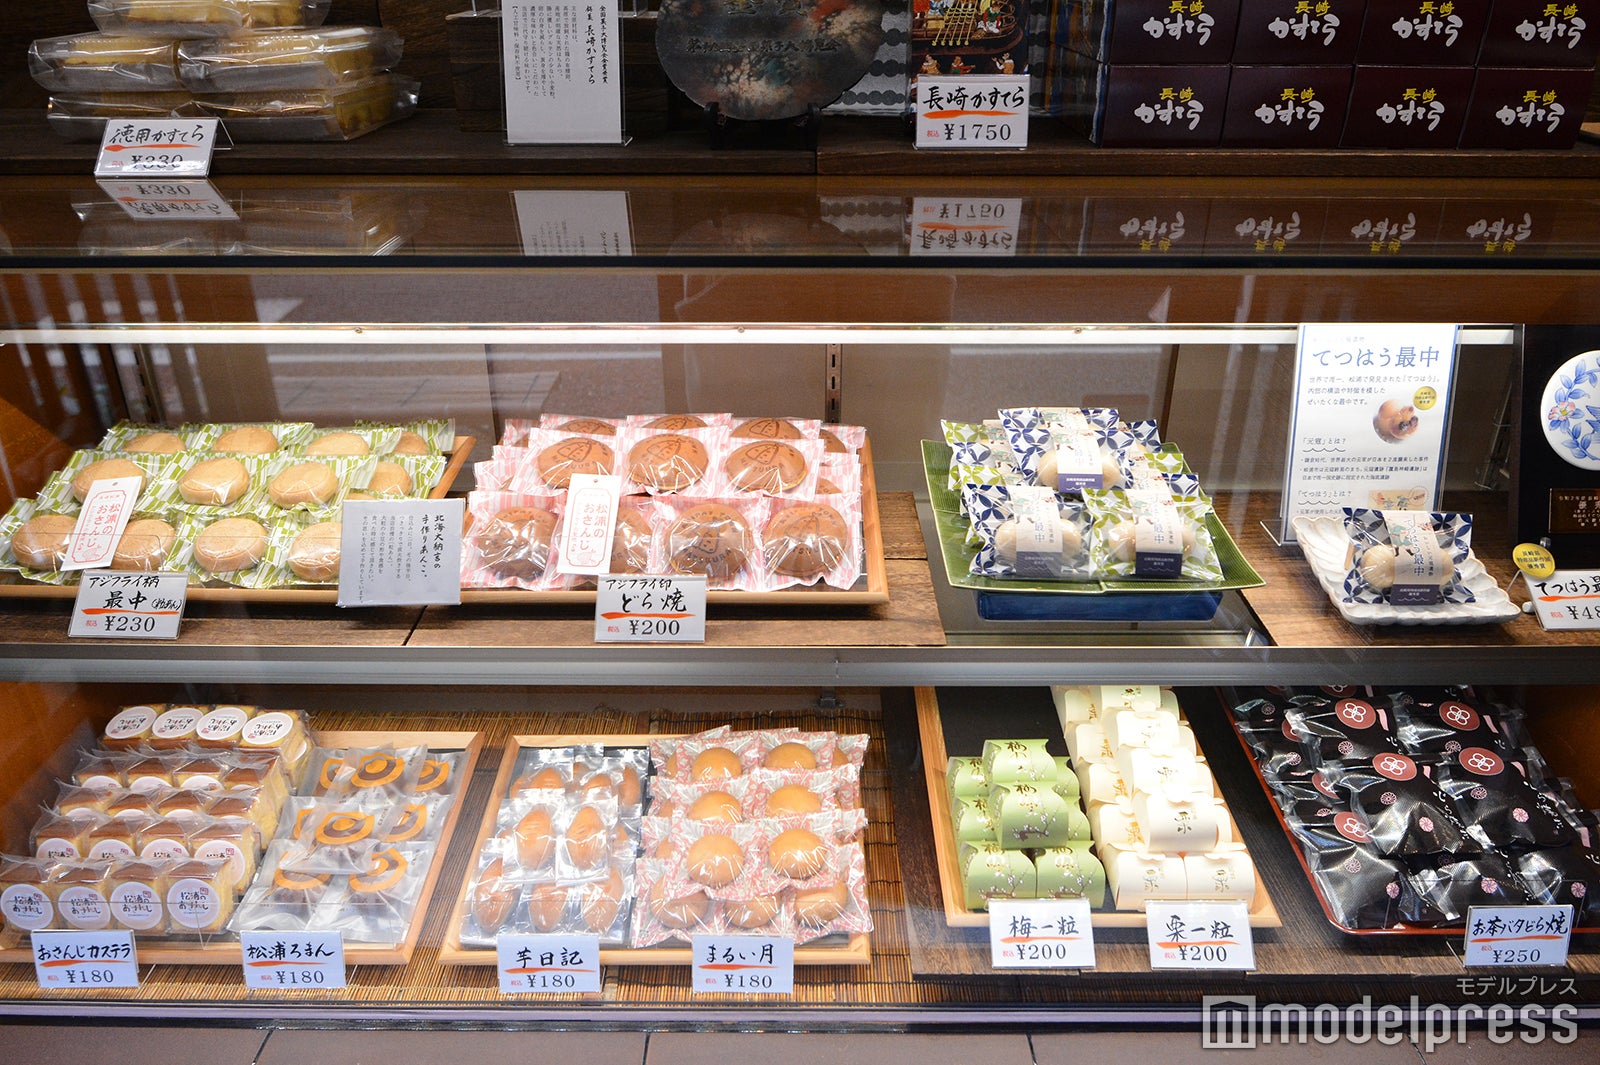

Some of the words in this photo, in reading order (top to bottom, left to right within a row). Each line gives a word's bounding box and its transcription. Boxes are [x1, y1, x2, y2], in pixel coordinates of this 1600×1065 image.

[1168, 0, 1204, 17] 長崎
[1294, 0, 1331, 17] 長崎
[1419, 1, 1455, 17] 長崎
[1543, 3, 1578, 20] 長崎
[1142, 13, 1215, 46] かすてら
[1268, 13, 1340, 46] かすてら
[1392, 13, 1463, 47] かすてら
[1515, 16, 1586, 49] かすてら
[585, 24, 597, 85] 長崎かすてら
[922, 85, 1025, 110] 長崎かすてら
[1159, 87, 1194, 103] 長崎
[1280, 87, 1315, 104] 長崎
[1402, 88, 1437, 104] 長崎
[1522, 90, 1557, 106] 長崎
[1134, 100, 1204, 130] かすてら
[1255, 100, 1324, 131] かすてら
[1376, 100, 1445, 131] かすてら
[1495, 102, 1565, 133] かすてら
[109, 124, 204, 143] 徳用かすてら
[944, 123, 1011, 140] ¥1750
[1312, 346, 1440, 368] てつはう最中
[1306, 398, 1368, 406] ぜいたくな最中です。
[87, 504, 108, 547] おさんじ
[102, 503, 121, 534] 松浦の
[579, 503, 594, 550] おさんじ
[593, 503, 608, 538] 松浦の
[433, 514, 445, 569] 北海大納言の
[89, 575, 160, 588] アジフライ柄
[605, 578, 672, 591] アジフライ印
[103, 590, 147, 610] 最中
[621, 588, 687, 613] どら焼
[104, 615, 156, 632] ¥230
[629, 619, 680, 635] ¥200
[1008, 915, 1080, 938] 梅一粒
[1165, 914, 1235, 941] 栗一粒
[1472, 910, 1568, 937] お茶バタどら焼
[37, 943, 132, 961] おさんじカステラ
[246, 941, 335, 961] 松浦ろまん
[515, 947, 584, 968] 芋日記
[705, 943, 774, 965] まるい月
[1016, 943, 1067, 961] ¥200
[1178, 945, 1227, 962] ¥200
[1493, 949, 1541, 963] ¥250
[66, 969, 114, 984] ¥180
[275, 970, 325, 985] ¥180
[526, 974, 575, 988] ¥180
[724, 973, 773, 989] ¥180
